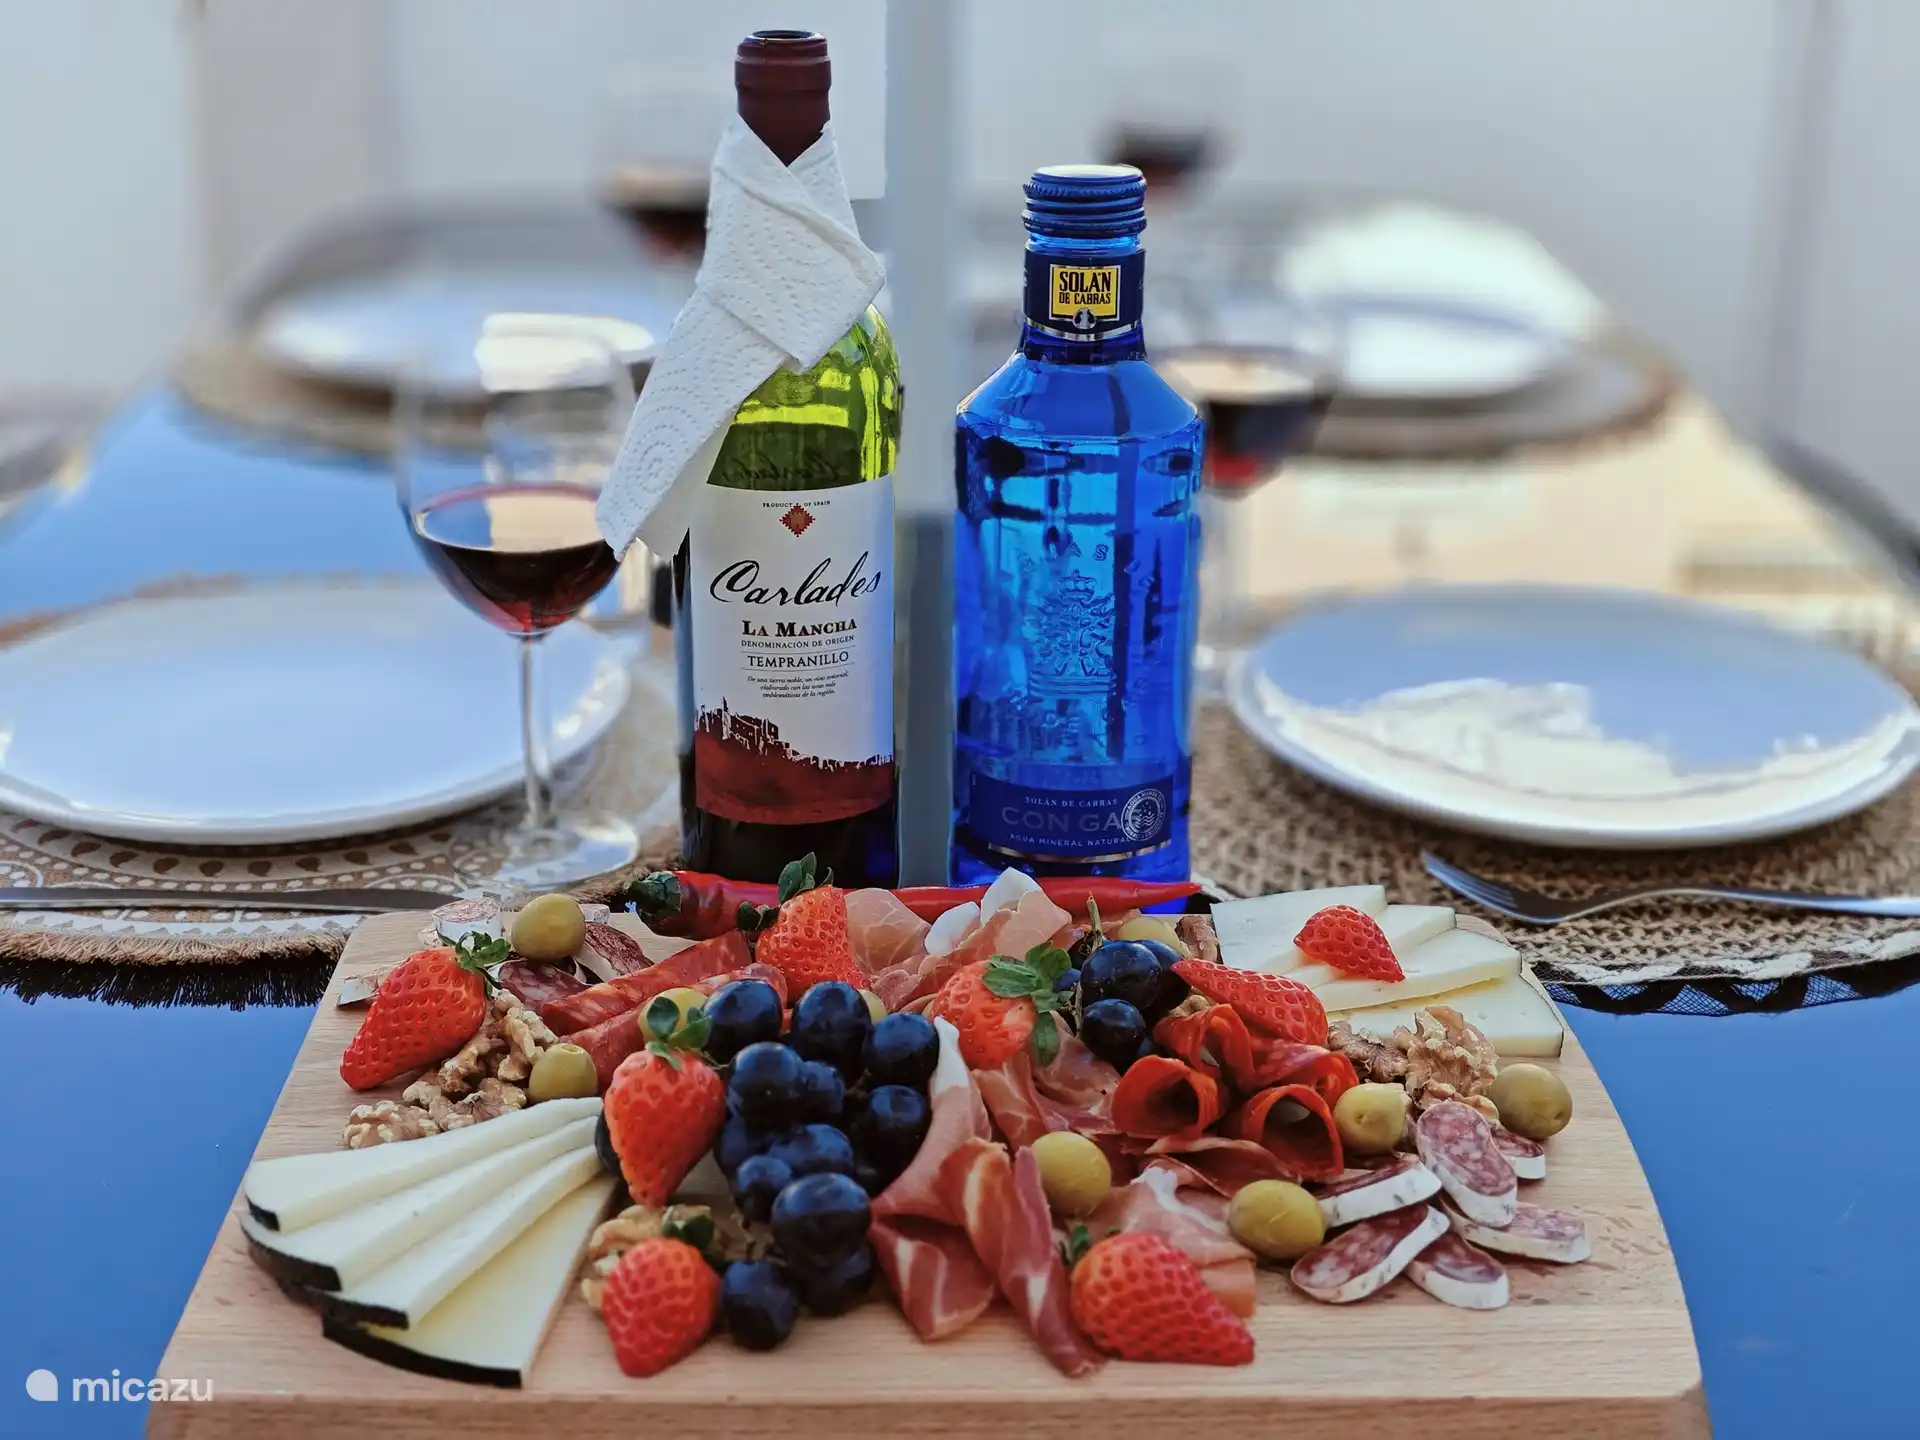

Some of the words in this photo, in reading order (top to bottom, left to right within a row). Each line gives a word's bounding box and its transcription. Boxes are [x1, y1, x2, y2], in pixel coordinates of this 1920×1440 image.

[1058, 293, 1071, 304] DE
[1074, 292, 1111, 305] CABRAS
[709, 550, 881, 608] Carlades
[741, 639, 809, 649] DENOMINACIÓN
[812, 640, 823, 648] DE
[825, 634, 854, 646] ORIGEN
[747, 651, 849, 668] TEMPRANILLO
[1024, 796, 1057, 806] SOLÁN
[1061, 799, 1075, 807] DE
[1079, 798, 1118, 808] CABRAS
[1001, 806, 1070, 833] CON
[1009, 833, 1035, 843] AGUA
[1038, 838, 1083, 847] MINERAL
[1087, 836, 1131, 847] NATURAL
